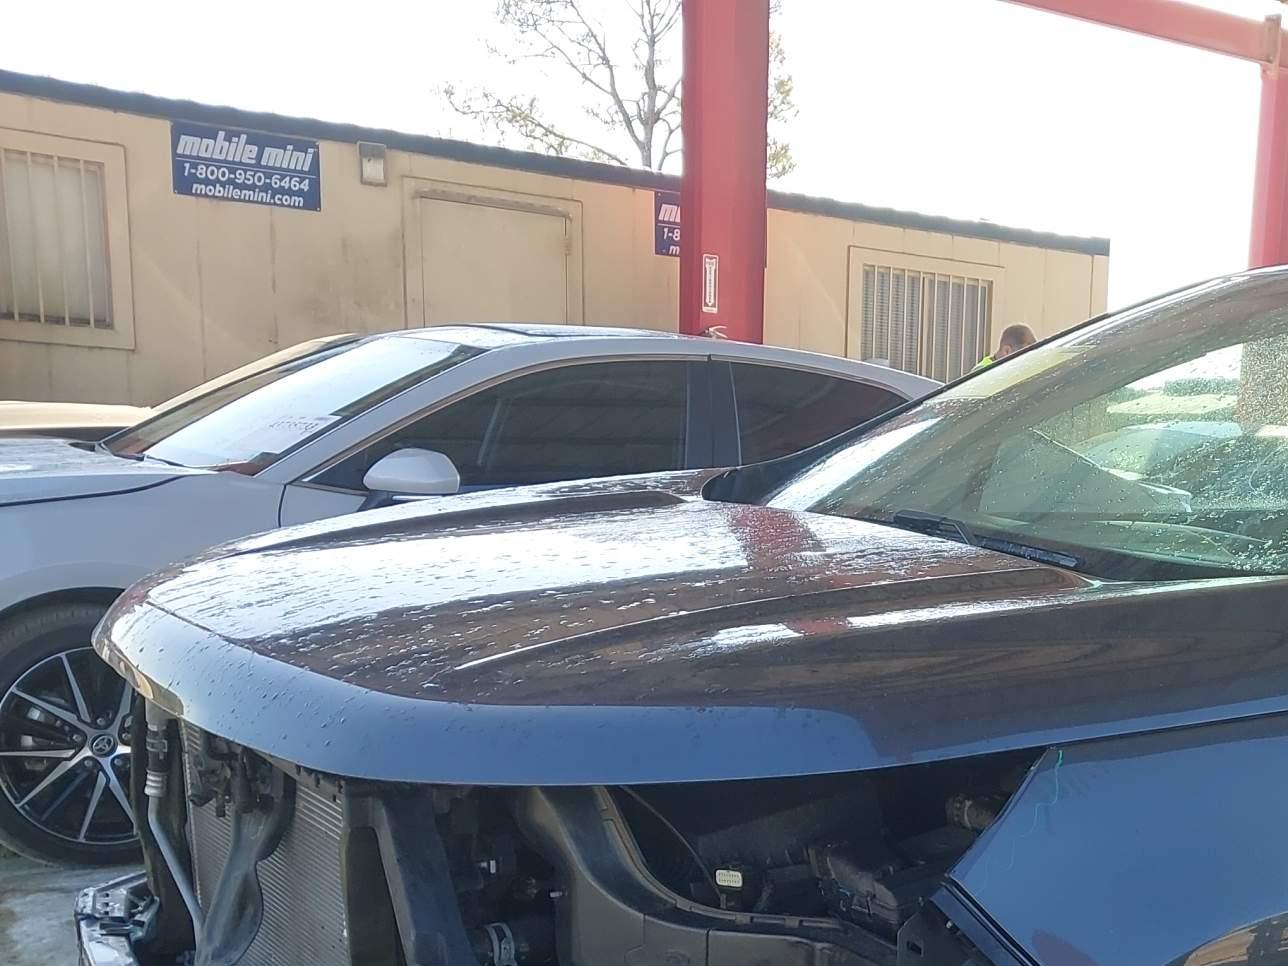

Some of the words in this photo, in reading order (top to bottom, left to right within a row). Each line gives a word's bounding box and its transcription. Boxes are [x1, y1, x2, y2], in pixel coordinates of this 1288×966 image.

[176, 131, 258, 164] mobile
[260, 145, 314, 171] mini
[183, 163, 310, 192] 1-800-950-6464
[192, 183, 304, 207] mobilemini.com
